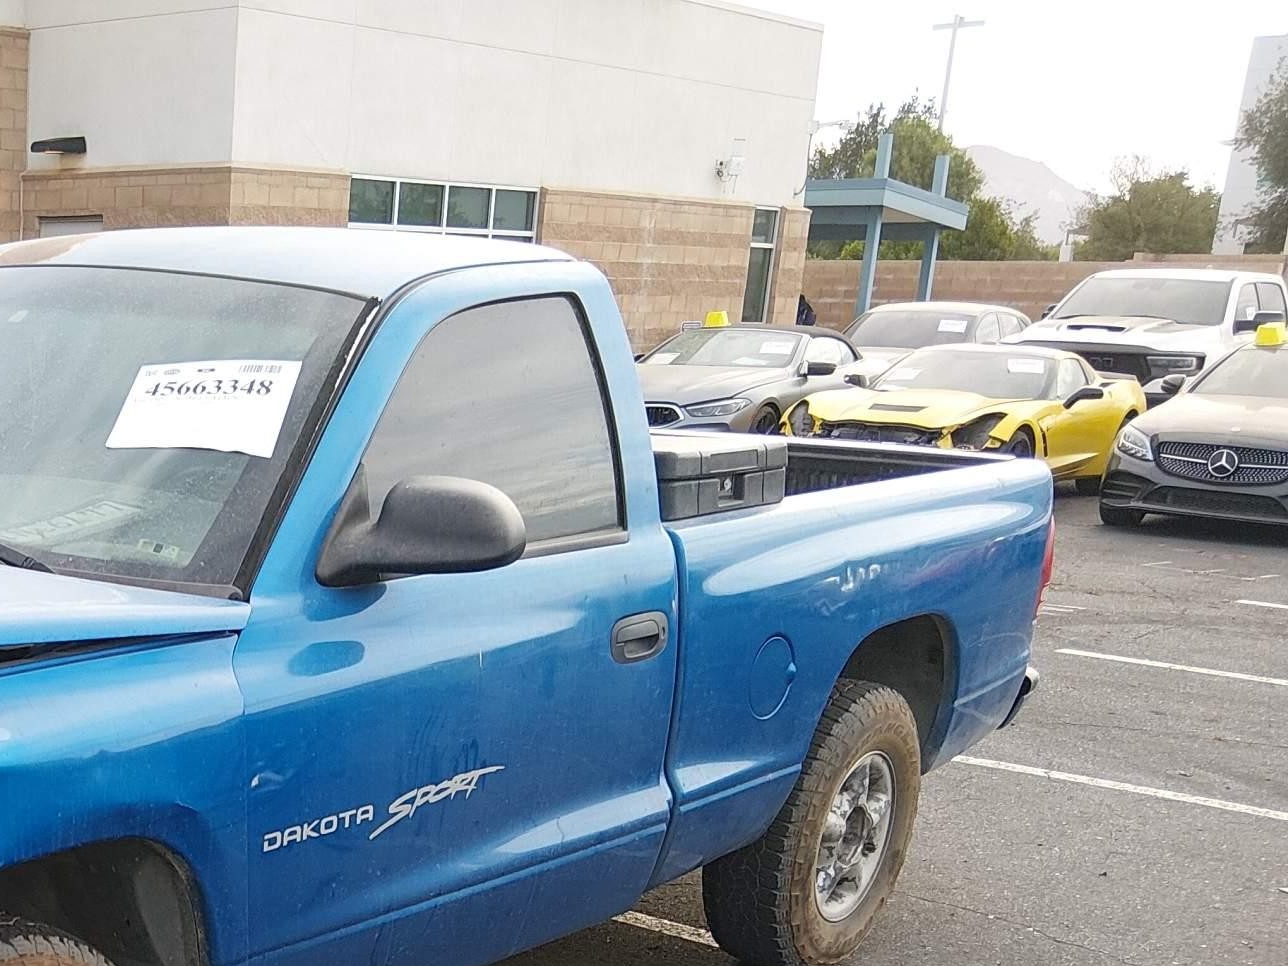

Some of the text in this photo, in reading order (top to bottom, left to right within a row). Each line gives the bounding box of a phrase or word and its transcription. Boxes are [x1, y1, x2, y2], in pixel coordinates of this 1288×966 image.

[144, 378, 275, 397] 45663348
[263, 765, 506, 853] DAKOTA SPORT
